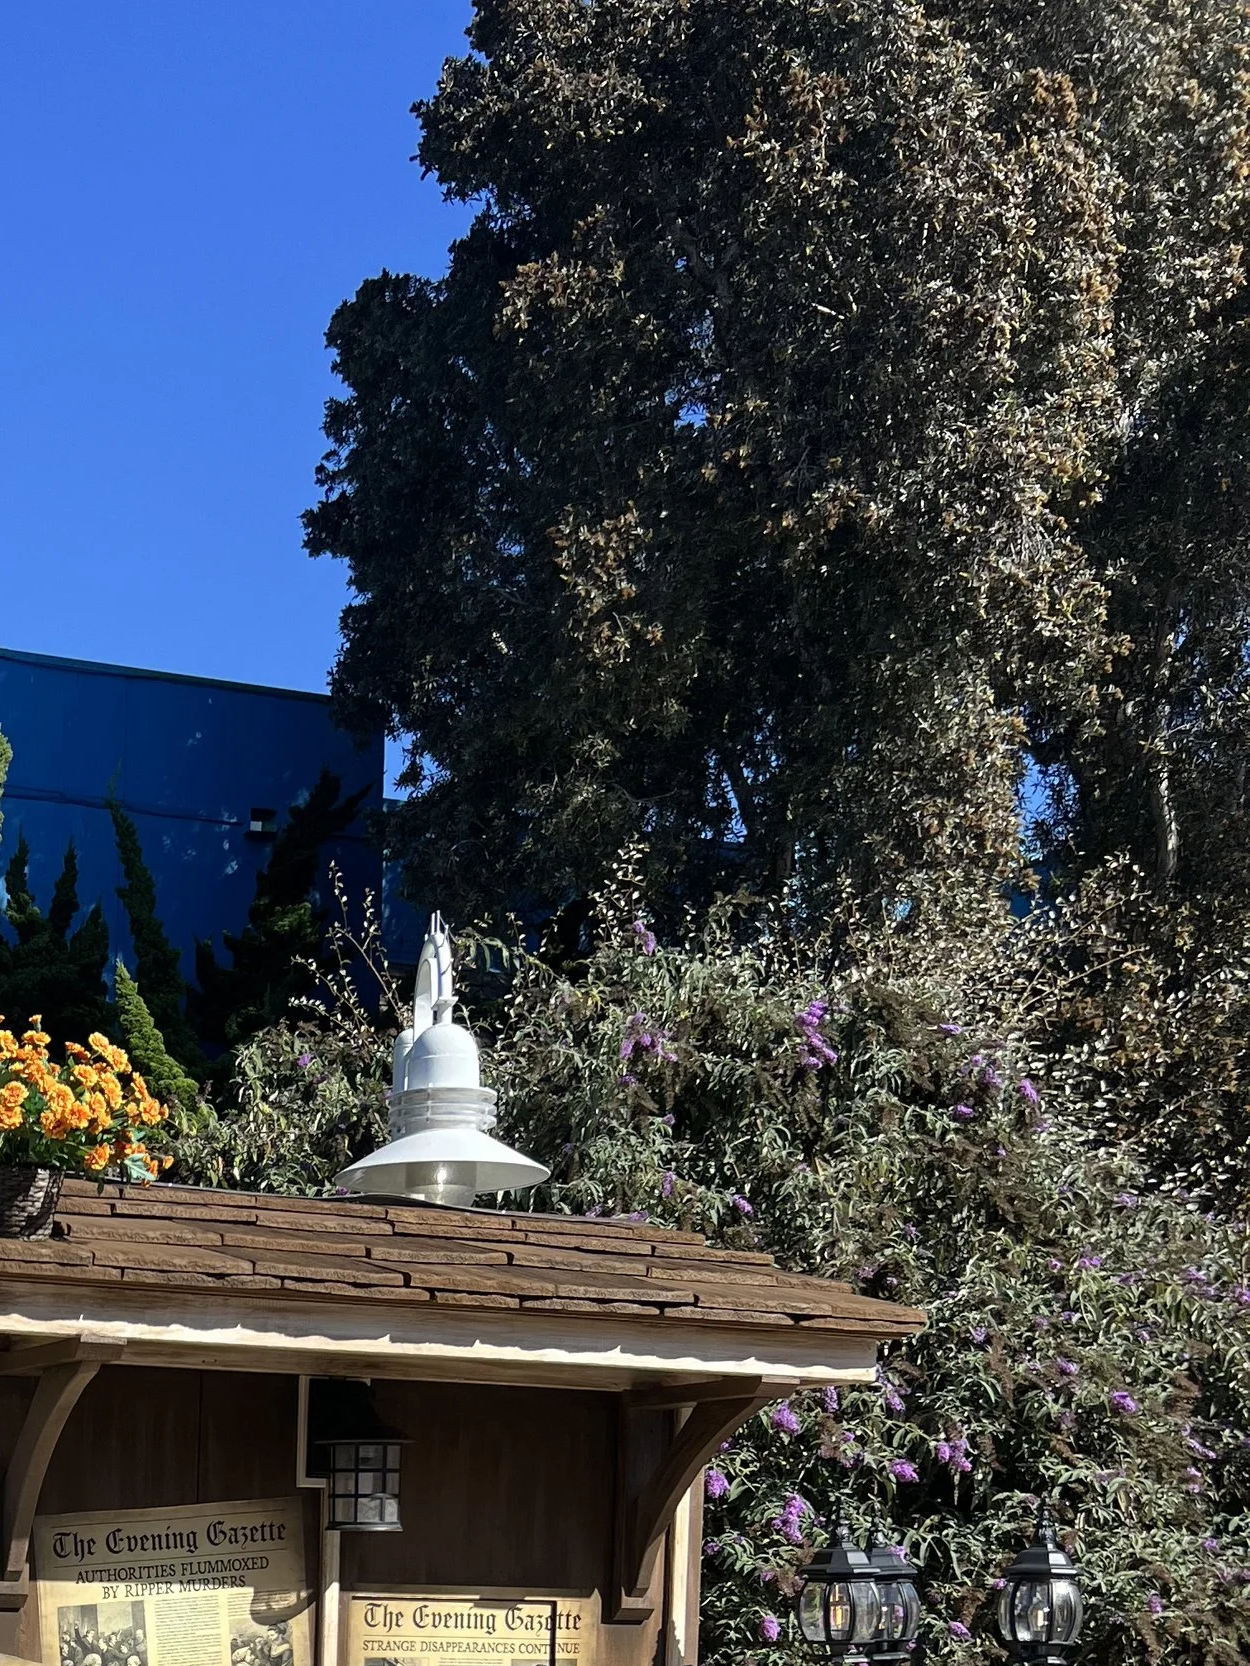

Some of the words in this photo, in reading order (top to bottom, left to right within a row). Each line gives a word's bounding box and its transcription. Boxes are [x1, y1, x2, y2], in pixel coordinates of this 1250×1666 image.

[52, 1531, 96, 1562] The
[106, 1526, 199, 1555] Evening
[206, 1520, 287, 1550] Gazette
[75, 1563, 177, 1584] AUTHORITIES
[181, 1556, 270, 1577] FLUMMOXED
[102, 1585, 121, 1600] BY
[124, 1581, 174, 1598] RIPPER
[178, 1574, 246, 1593] MURDERS
[364, 1603, 404, 1632] The
[412, 1606, 497, 1635] Evening
[505, 1606, 582, 1637] Gazette
[362, 1640, 417, 1652] STRANGE
[420, 1641, 516, 1654] DISAPPEARANCES
[518, 1643, 580, 1655] CONTNUE
